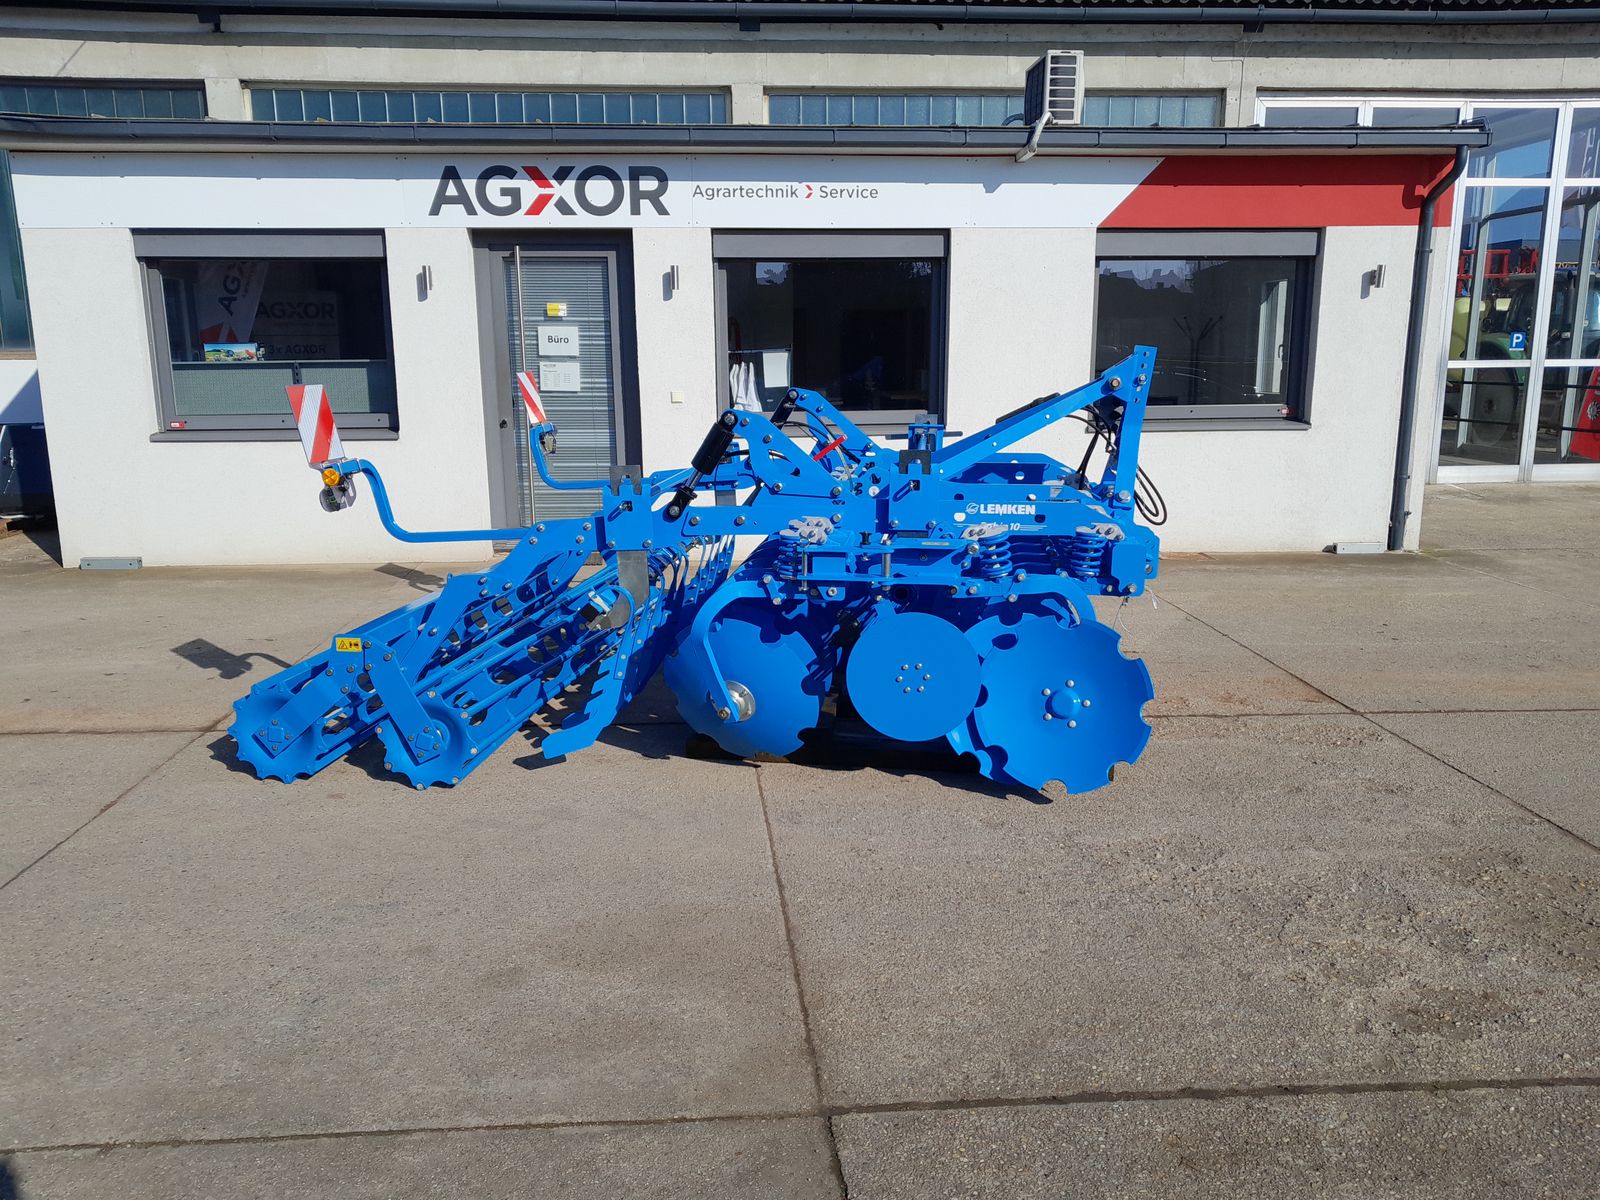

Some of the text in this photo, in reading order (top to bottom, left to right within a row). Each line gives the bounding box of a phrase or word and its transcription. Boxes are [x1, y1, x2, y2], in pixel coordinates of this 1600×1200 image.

[428, 165, 671, 217] AGXOR
[692, 183, 879, 201] Agrartechnik Service
[547, 335, 569, 344] Büro
[1512, 333, 1523, 348] P
[980, 503, 1035, 515] LEMKEN
[1009, 522, 1020, 531] 10
